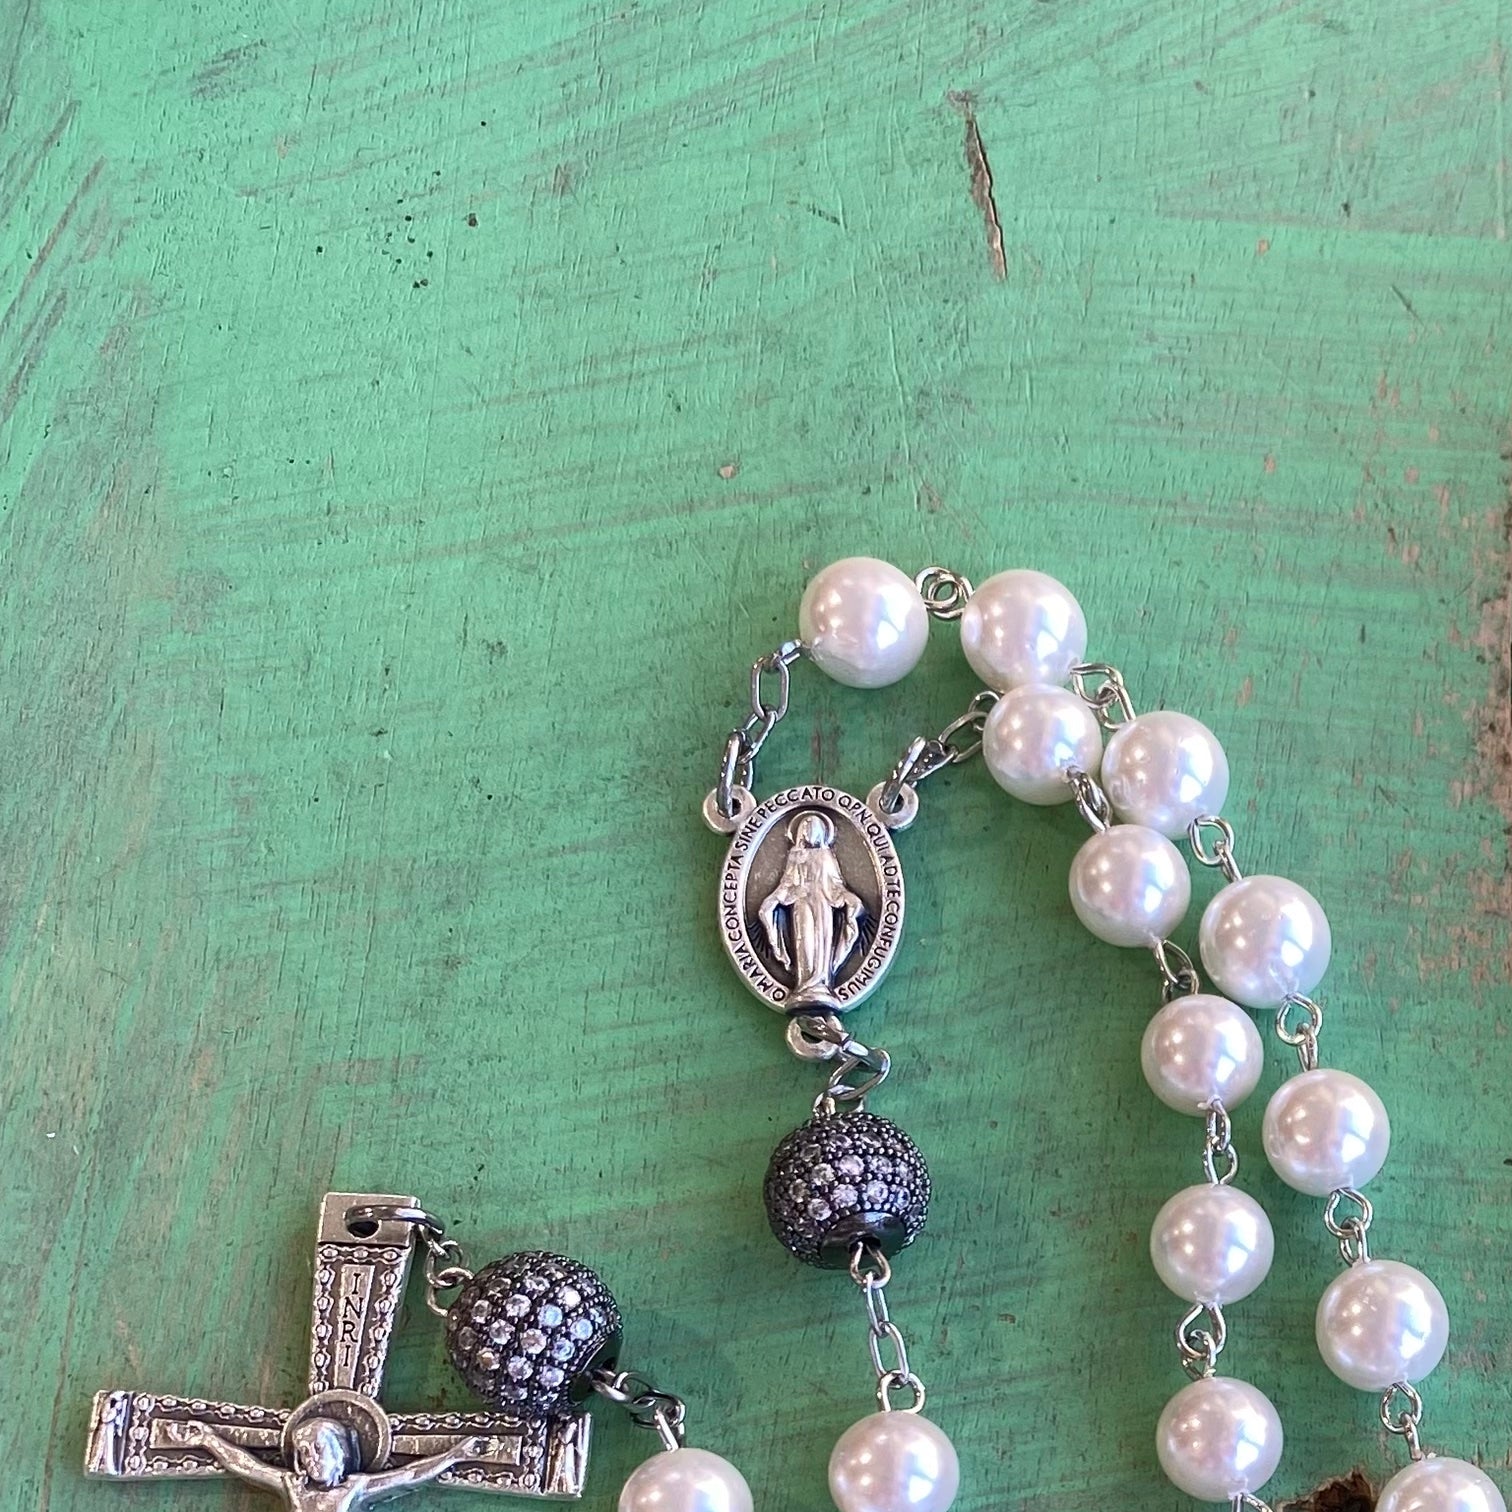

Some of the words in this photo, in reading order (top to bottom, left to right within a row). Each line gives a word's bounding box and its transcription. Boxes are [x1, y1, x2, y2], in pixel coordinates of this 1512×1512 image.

[756, 787, 836, 819] PECCATO
[735, 817, 763, 851] SINE
[866, 822, 890, 852] QUI
[880, 854, 898, 877] AD
[723, 855, 745, 942] CONCEPTA
[886, 879, 901, 898] TE
[734, 942, 774, 992] MARIA
[838, 900, 900, 1002] CONFUGIMUS
[340, 1272, 364, 1367] INRI
